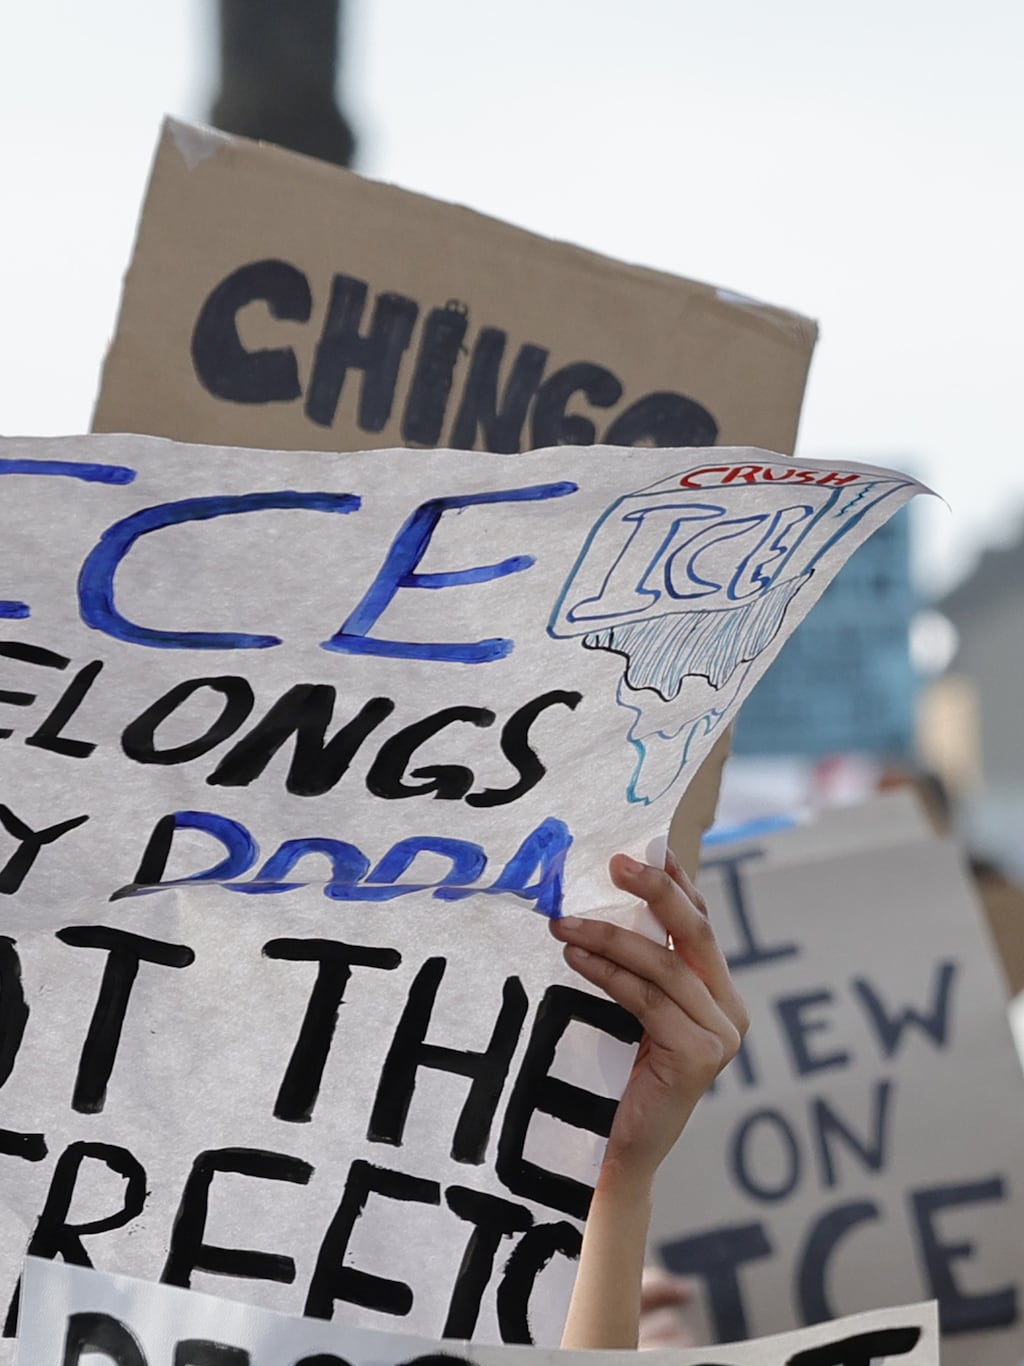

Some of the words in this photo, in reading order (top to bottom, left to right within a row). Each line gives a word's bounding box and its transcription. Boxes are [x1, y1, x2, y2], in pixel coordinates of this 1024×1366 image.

[680, 465, 861, 489] CRUSH
[262, 938, 645, 1221] THE
[730, 1080, 894, 1208] ON
